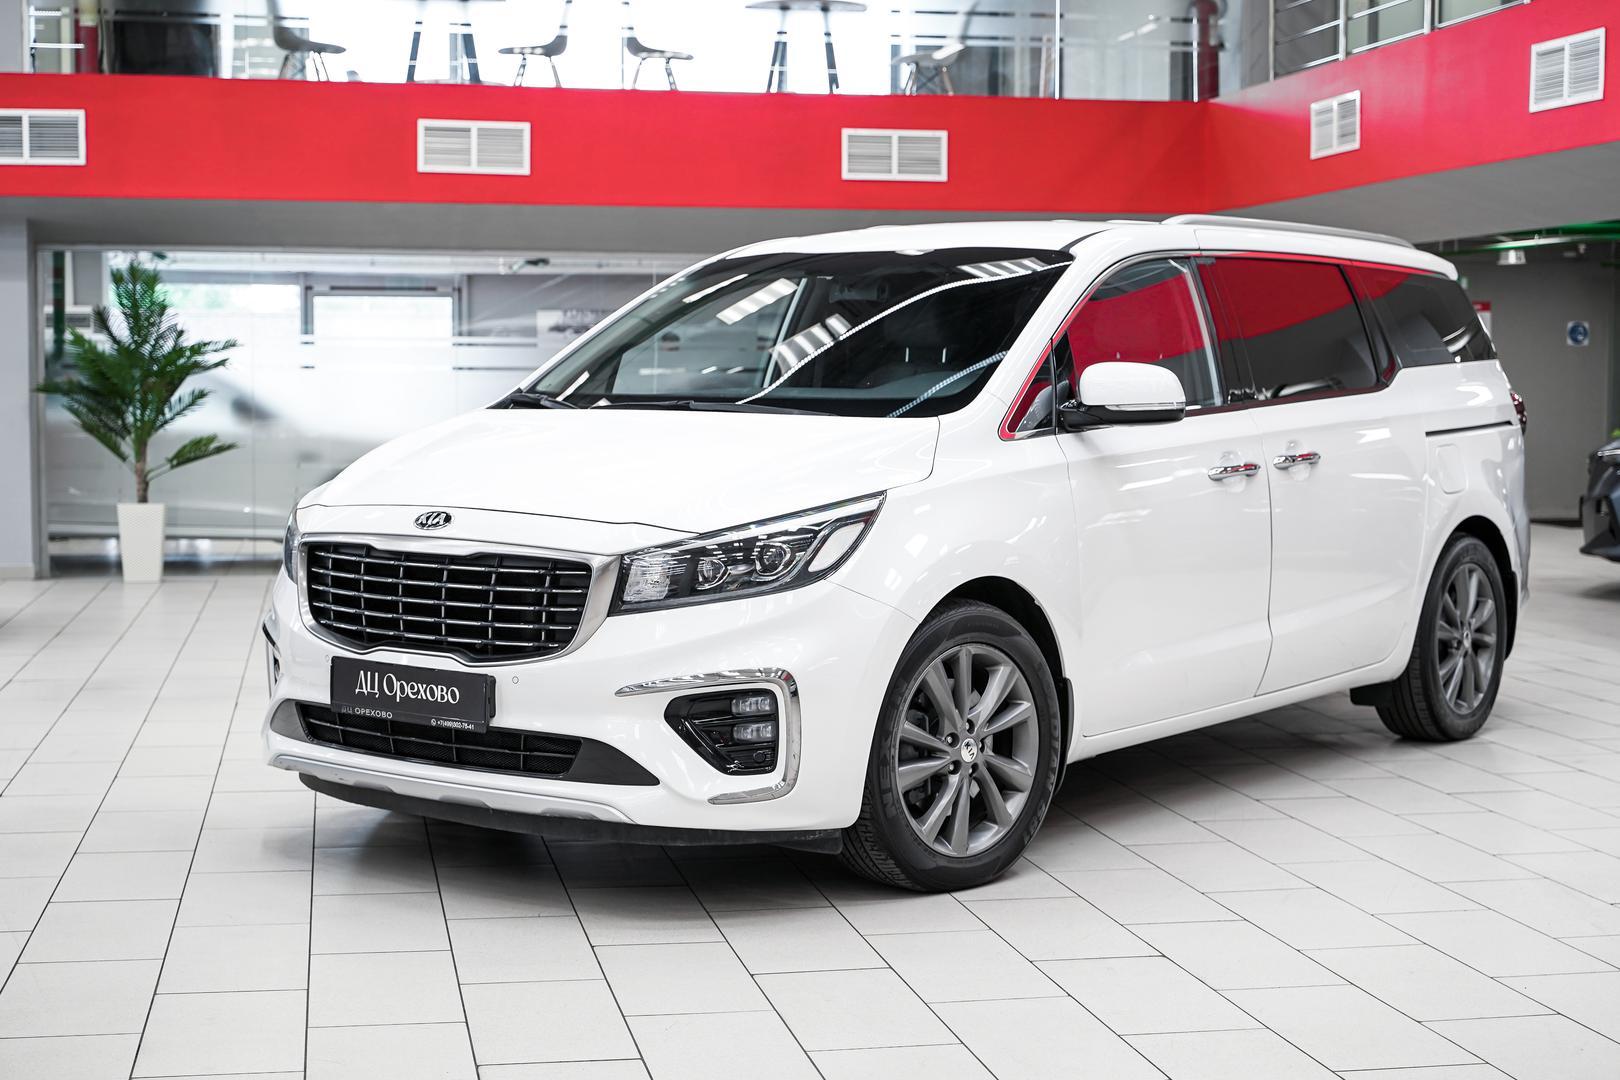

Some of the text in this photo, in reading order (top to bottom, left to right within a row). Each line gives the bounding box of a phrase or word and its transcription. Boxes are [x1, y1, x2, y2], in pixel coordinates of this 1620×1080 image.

[417, 512, 447, 528] KIA
[355, 670, 460, 704] ДЦ Орехово
[354, 707, 393, 719] ОРЕХОВО
